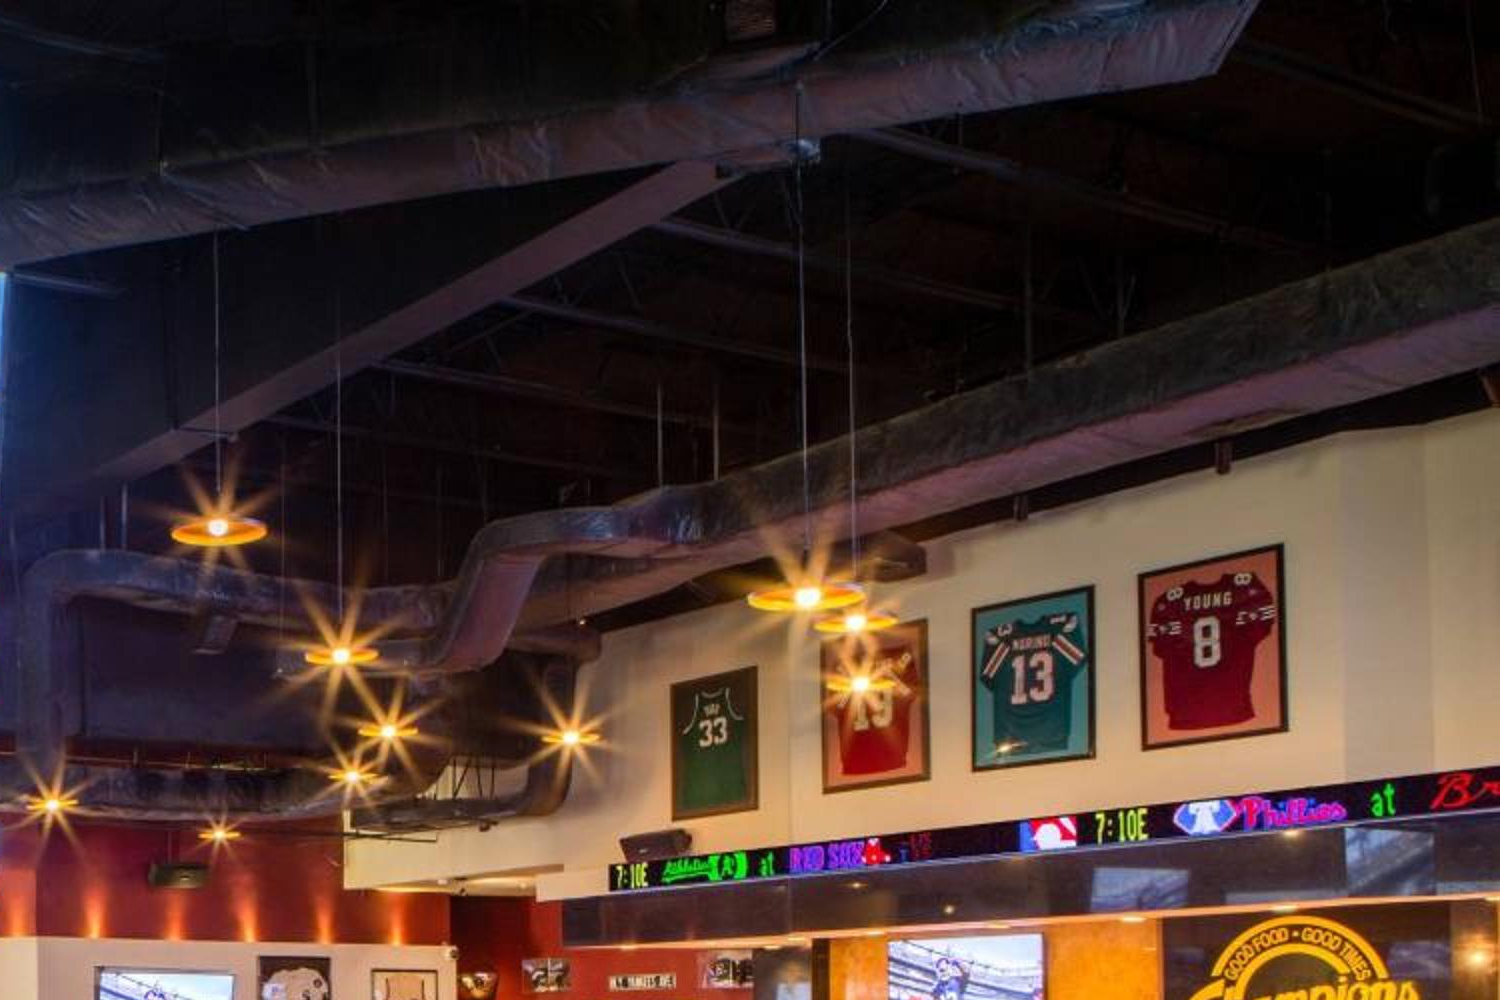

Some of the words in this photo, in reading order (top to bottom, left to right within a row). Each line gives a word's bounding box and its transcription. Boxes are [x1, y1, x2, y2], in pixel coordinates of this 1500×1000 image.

[1184, 591, 1233, 611] YOUNG
[1193, 615, 1222, 668] 8
[1011, 651, 1055, 705] 13
[699, 717, 728, 747] 33
[1095, 807, 1149, 845] 7:10E
[1234, 796, 1348, 832] Phillies
[1370, 782, 1396, 817] at
[1223, 941, 1255, 981] GOOD
[1251, 927, 1289, 954] FOOD
[1301, 927, 1343, 951] GOOD
[1339, 941, 1372, 981] TIMES
